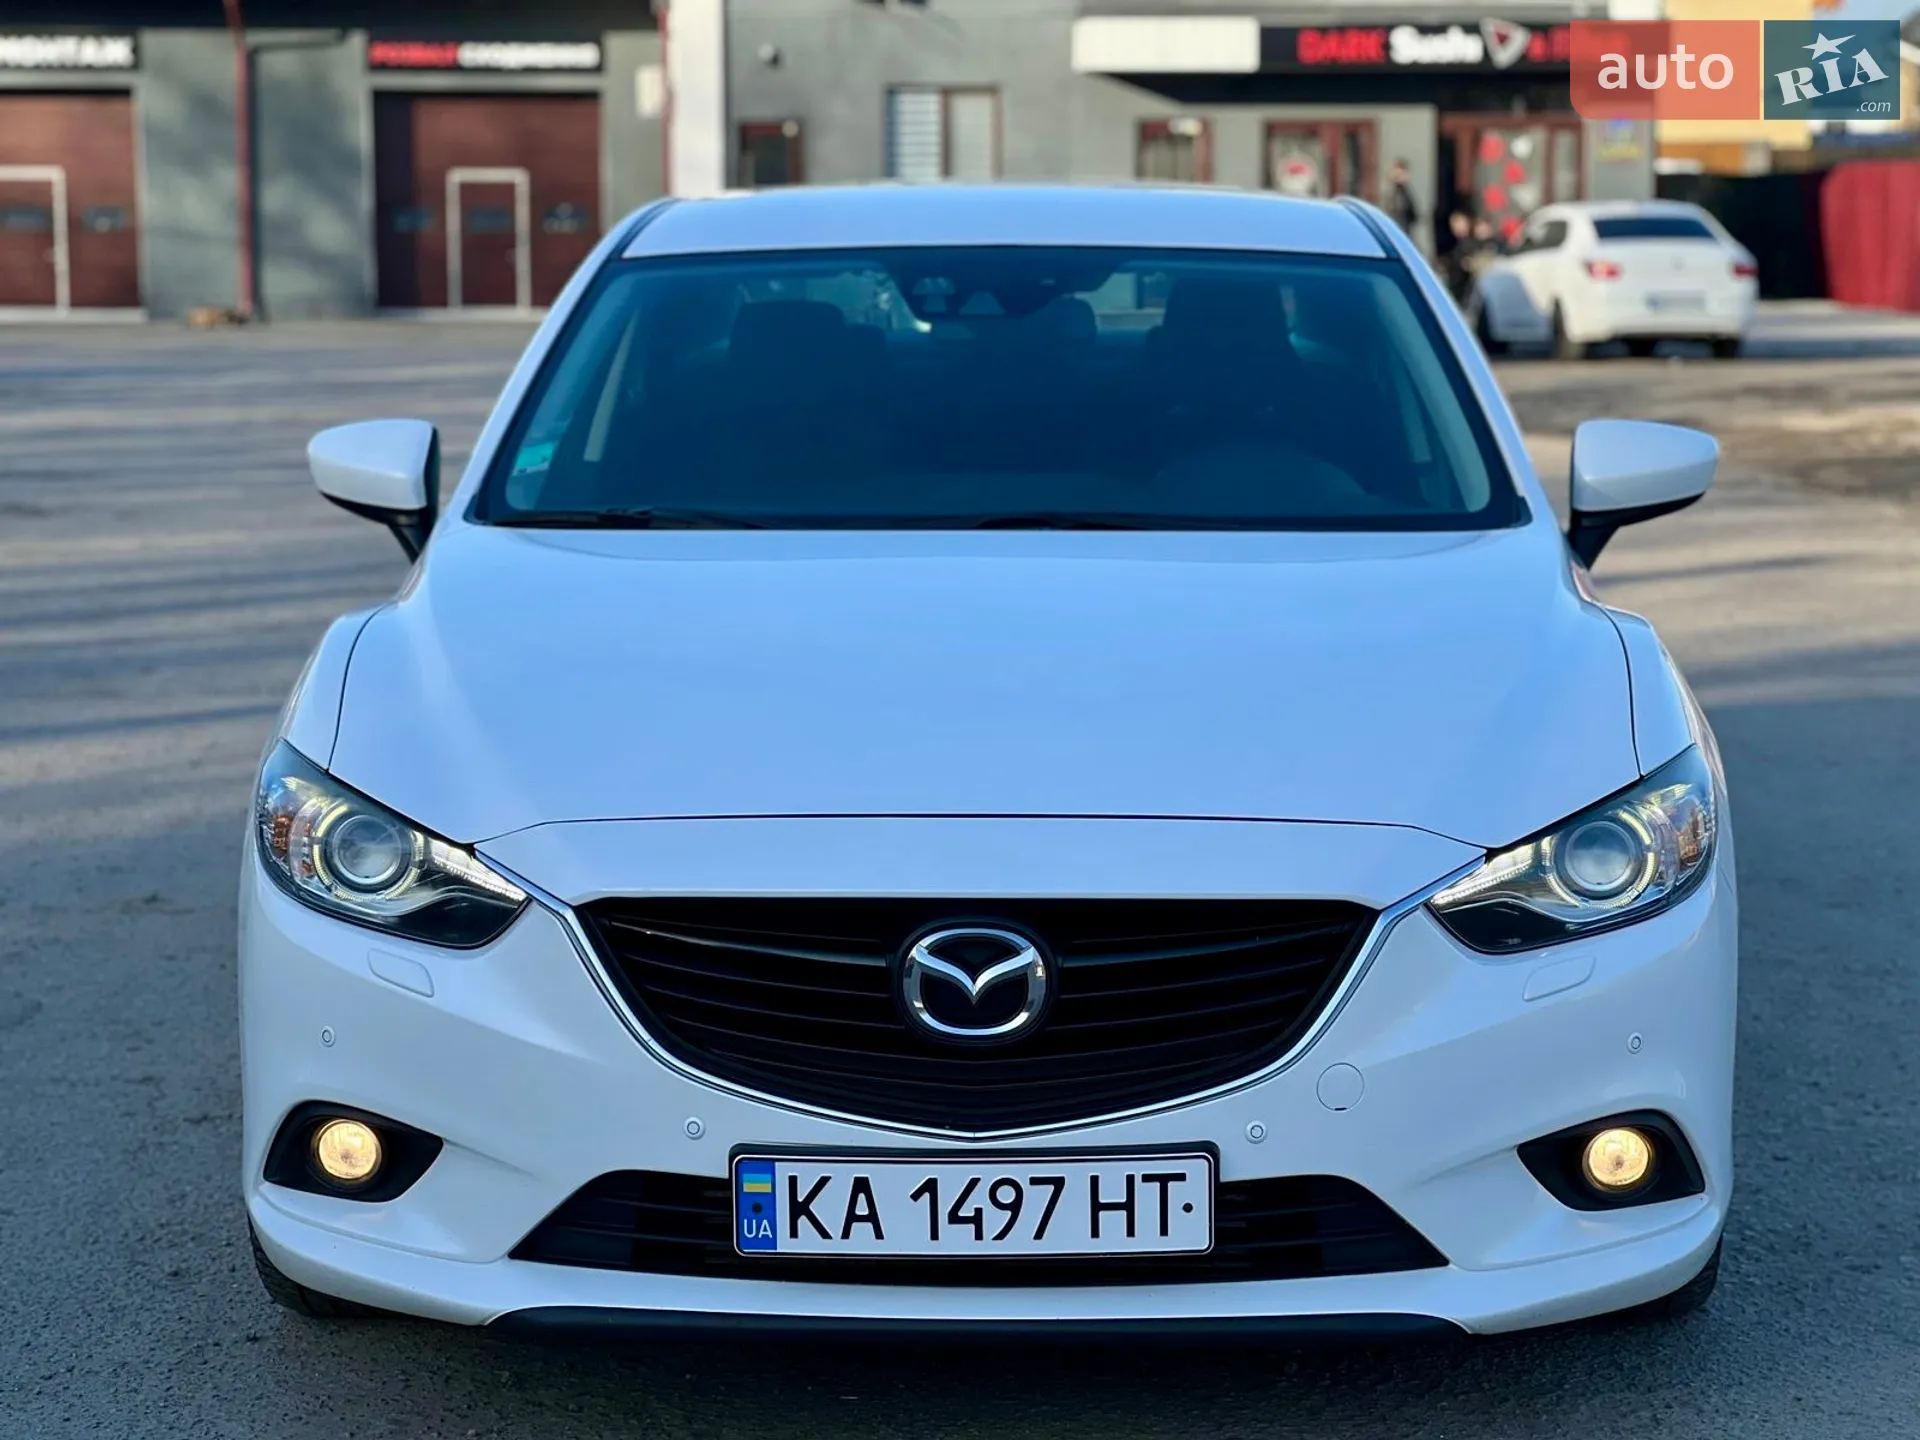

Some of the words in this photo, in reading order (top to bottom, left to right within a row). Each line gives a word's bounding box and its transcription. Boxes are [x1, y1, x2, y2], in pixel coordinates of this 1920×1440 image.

[1298, 28, 1387, 63] DARK
[787, 1174, 885, 1240] KA
[909, 1176, 1066, 1242] 1497
[1089, 1172, 1187, 1238] HT
[743, 1220, 773, 1239] UA
